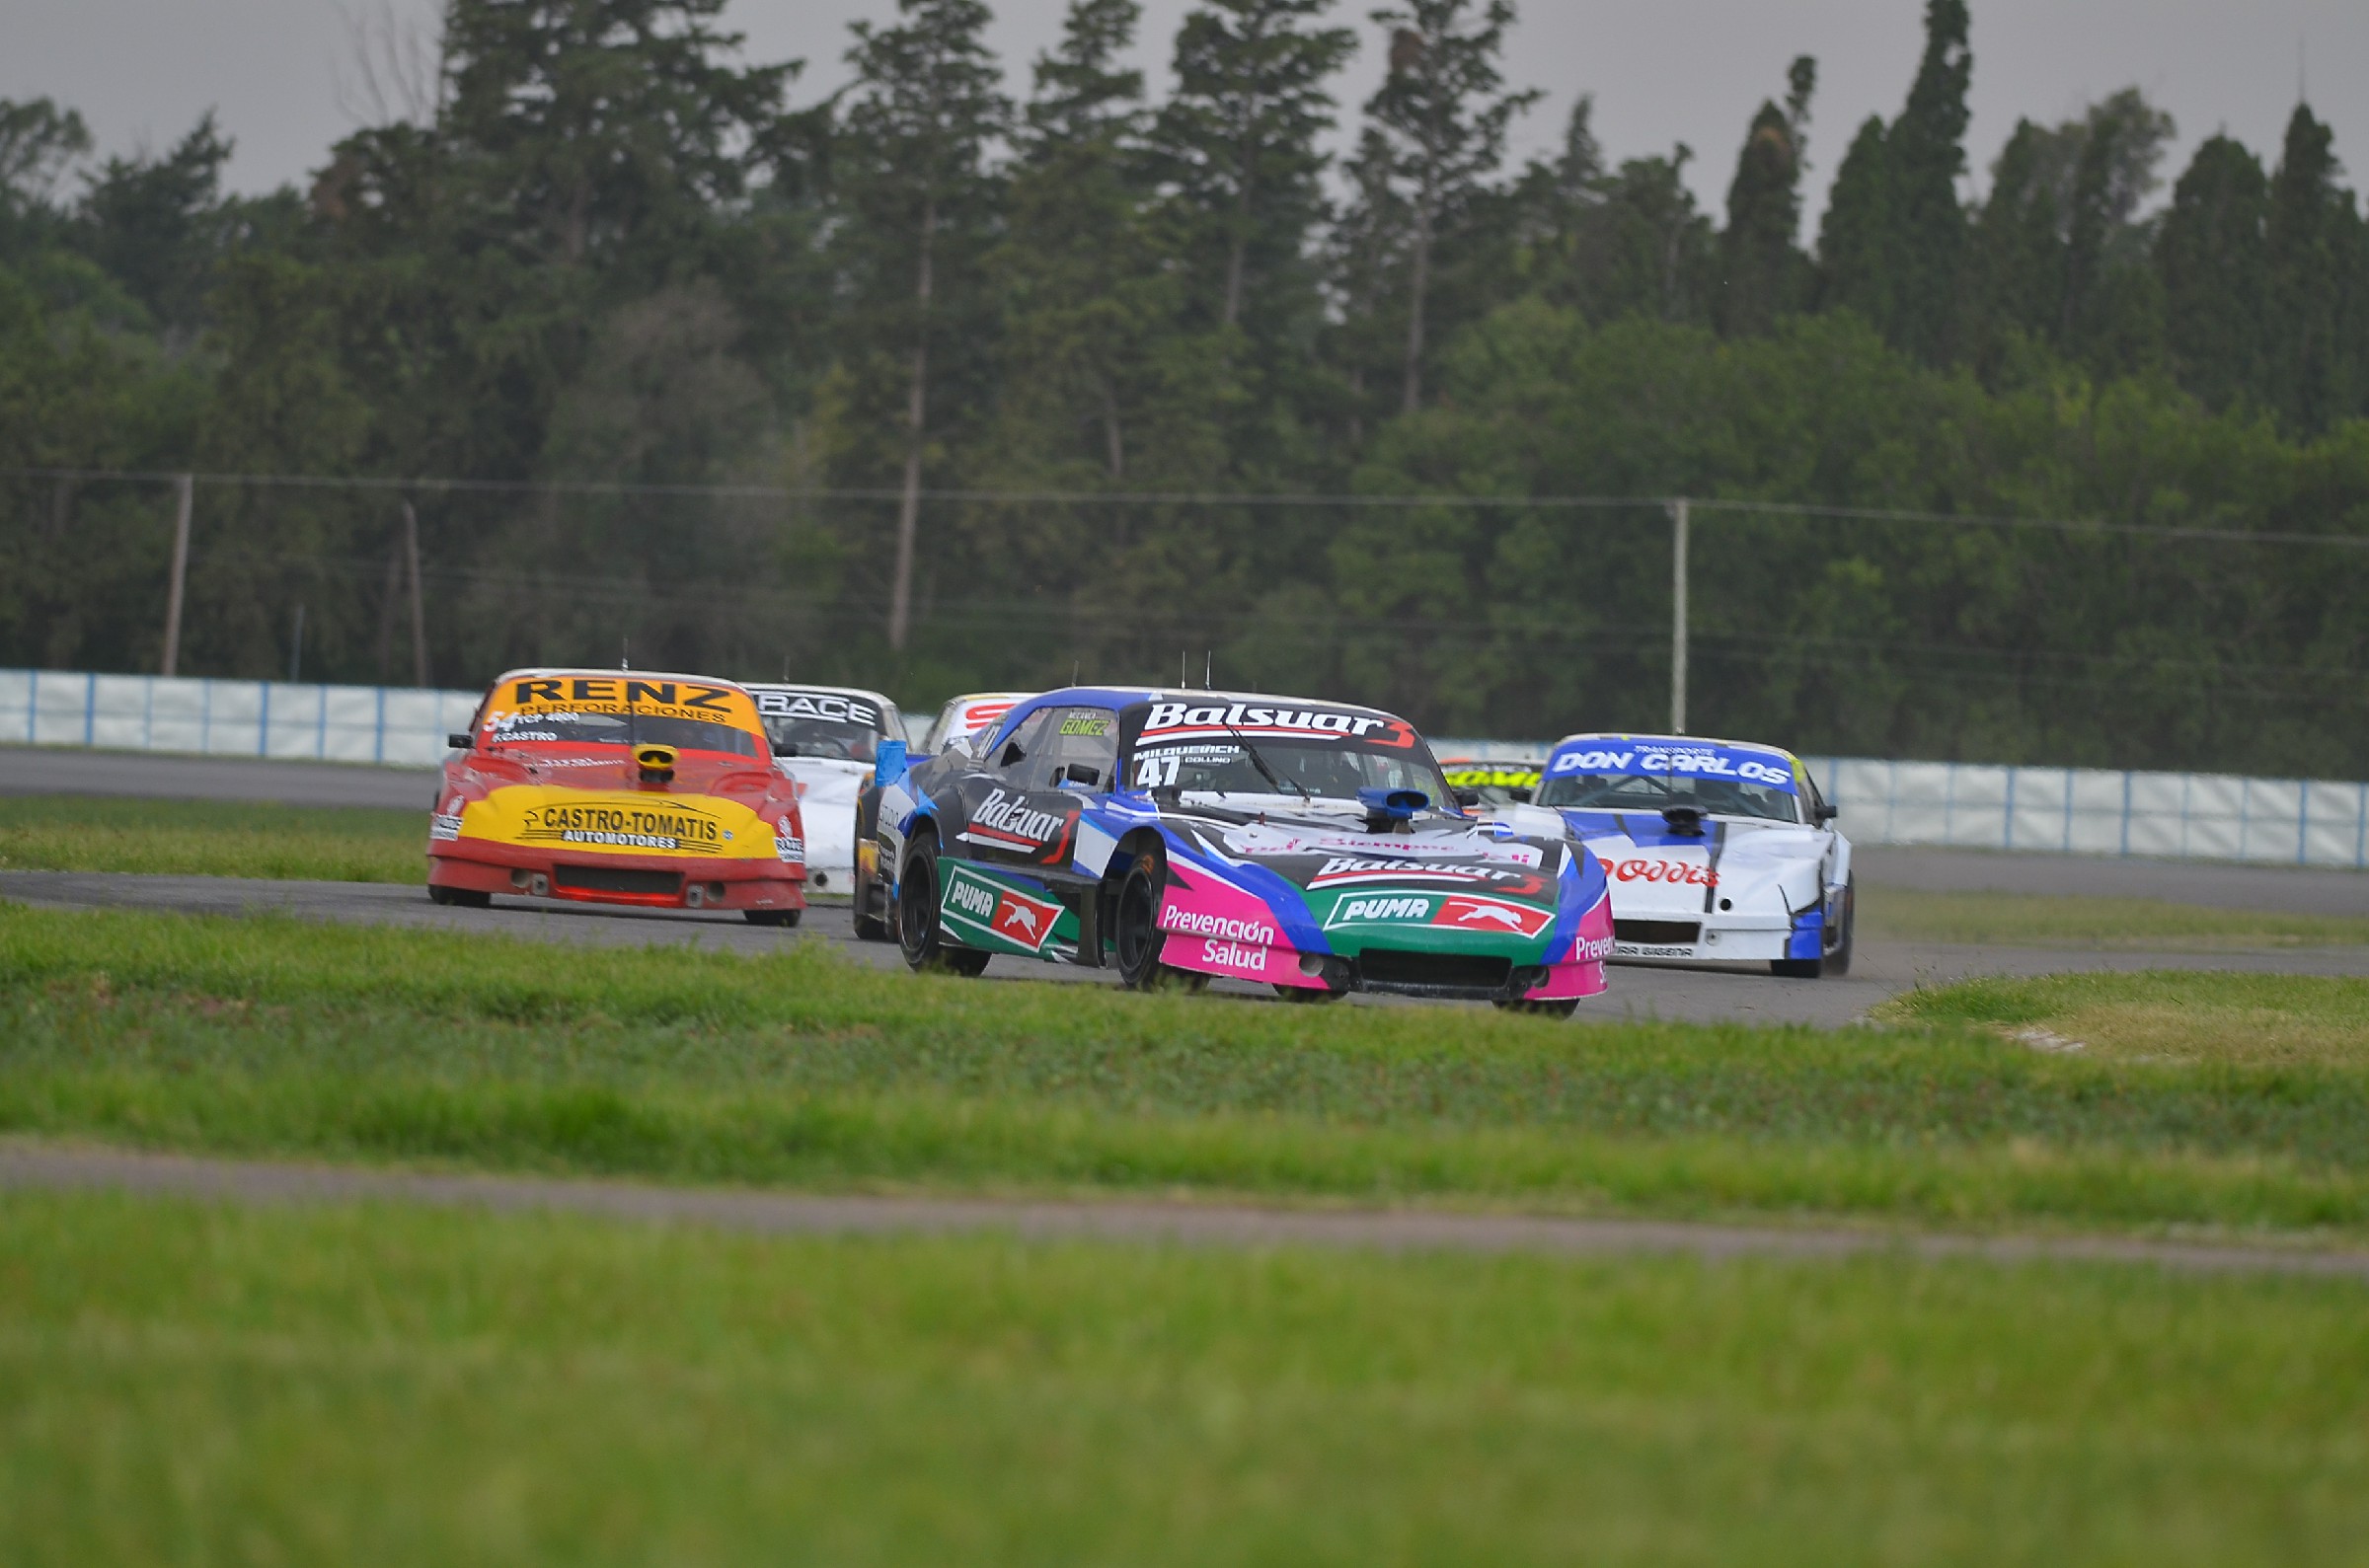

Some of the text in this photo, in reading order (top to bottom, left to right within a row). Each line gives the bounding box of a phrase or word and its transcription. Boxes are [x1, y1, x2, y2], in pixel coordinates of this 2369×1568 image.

[516, 679, 733, 712] RENZ
[520, 703, 726, 723] PERFORACIONES
[1059, 719, 1109, 736] GOMEZ
[1144, 702, 1384, 736] Balsuar
[1136, 757, 1182, 788] 47
[1552, 752, 1792, 784] DON CARLOS
[544, 808, 719, 840] CASTRO-TOMATIS
[563, 830, 679, 849] AUTOMOTORES
[1318, 858, 1526, 881] Balsuar
[951, 881, 994, 918] PUMA
[1342, 898, 1429, 921] PUMA
[1163, 905, 1274, 945] Prevención
[1202, 938, 1267, 970] Salud
